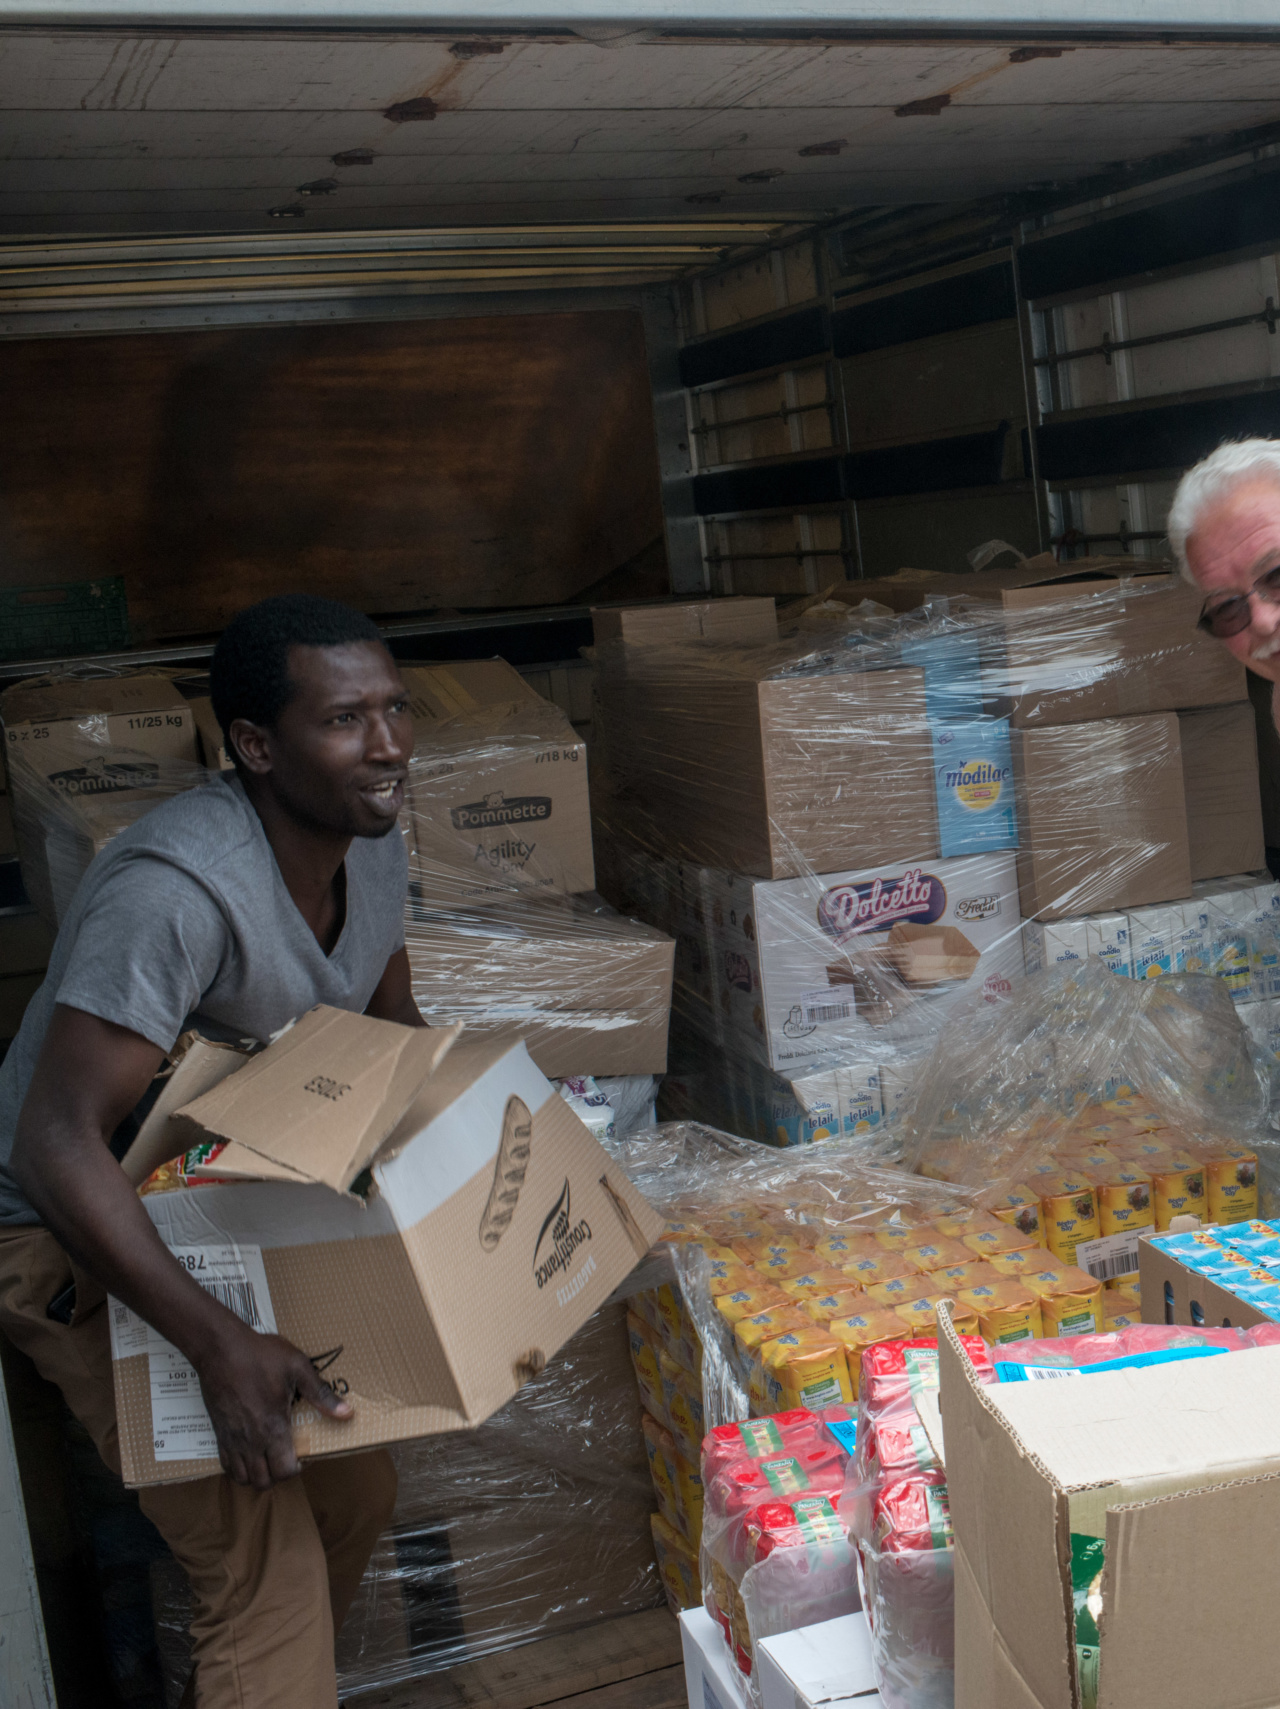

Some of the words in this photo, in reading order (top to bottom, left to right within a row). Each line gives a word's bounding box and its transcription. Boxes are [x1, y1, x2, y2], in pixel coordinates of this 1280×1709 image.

[128, 716, 162, 729] 11/25
[166, 715, 183, 728] kg
[33, 728, 50, 740] 25
[563, 750, 579, 763] kg
[945, 763, 1010, 788] modilac
[458, 803, 547, 826] Pommette
[1001, 806, 1015, 837] 1
[474, 839, 536, 867] Agility
[824, 868, 932, 930] Dolcetto
[1057, 952, 1079, 962] candia
